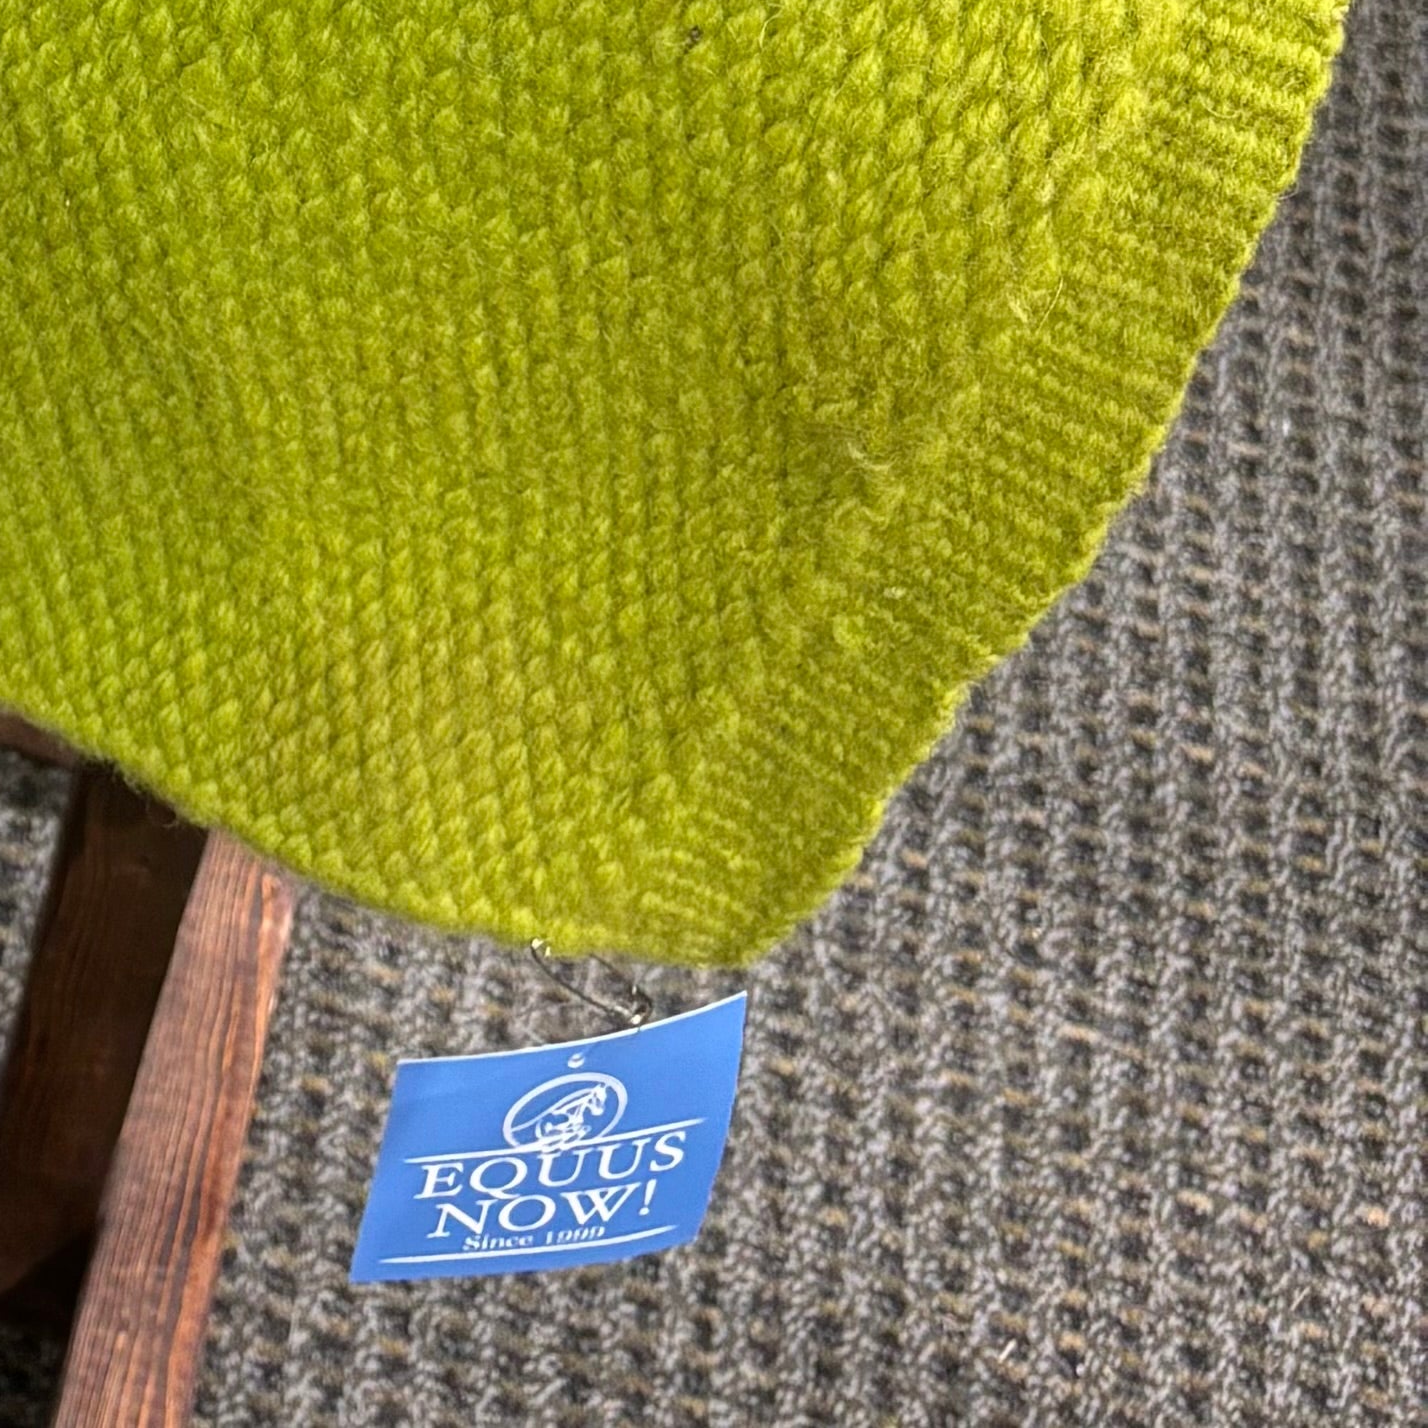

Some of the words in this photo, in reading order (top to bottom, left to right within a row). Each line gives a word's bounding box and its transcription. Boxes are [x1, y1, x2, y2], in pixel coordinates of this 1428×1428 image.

[413, 1130, 687, 1202] EQUUS
[426, 1178, 657, 1239] NOW!
[461, 1233, 534, 1251] Since
